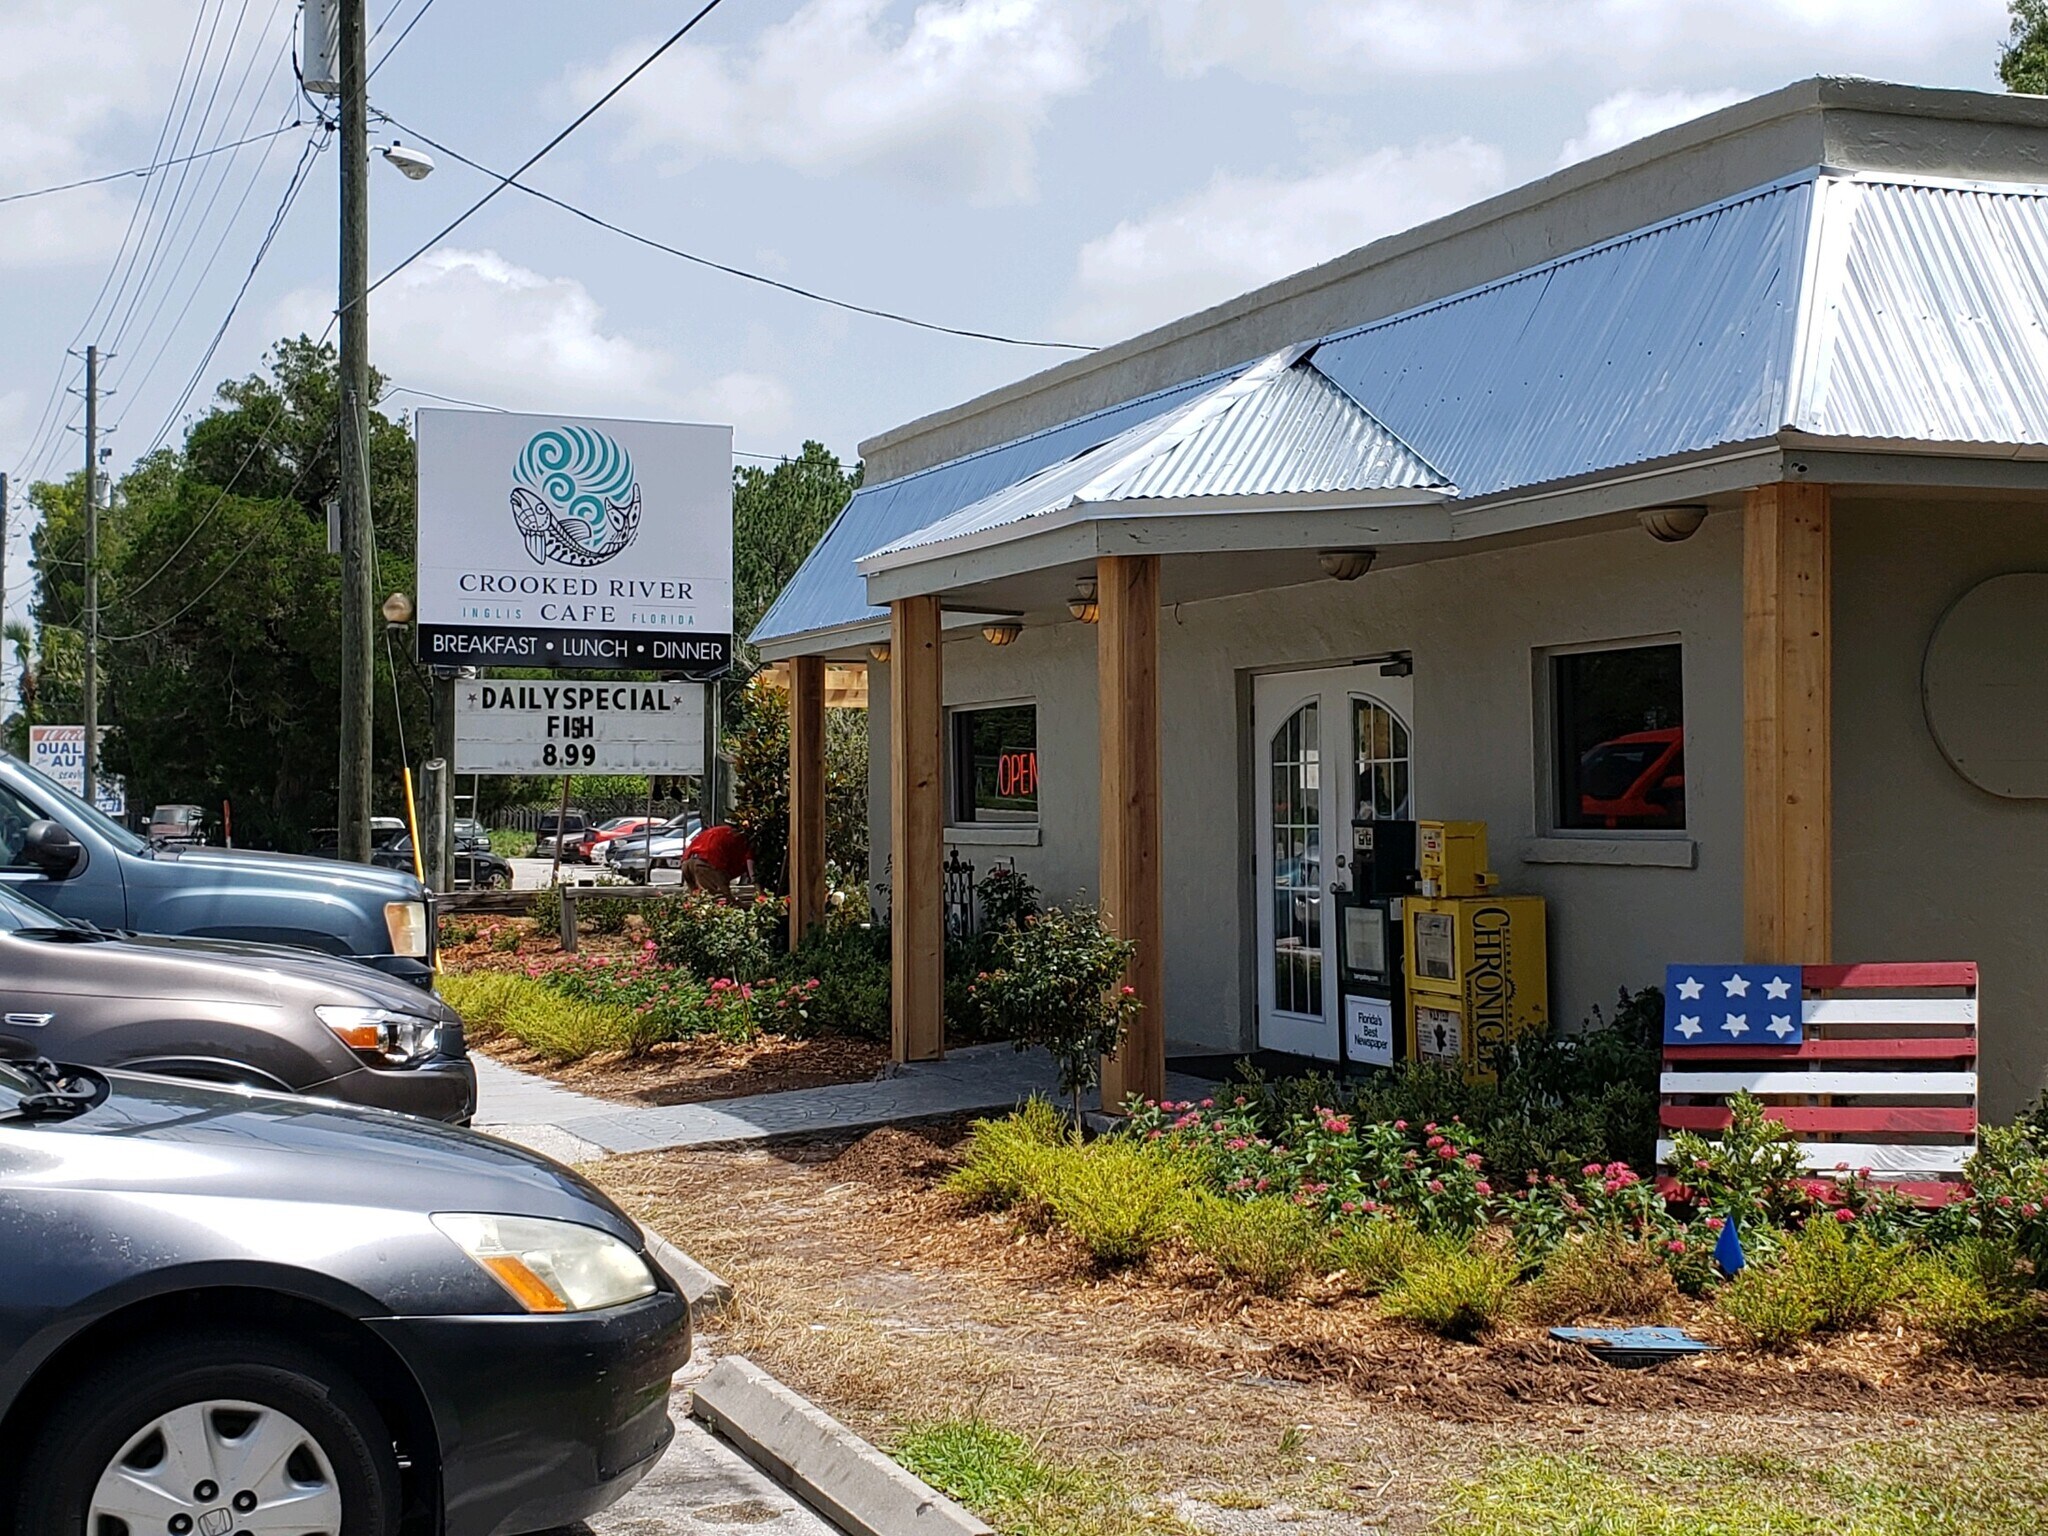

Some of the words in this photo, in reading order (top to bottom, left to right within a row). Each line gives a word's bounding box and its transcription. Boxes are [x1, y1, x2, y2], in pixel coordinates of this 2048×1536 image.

[459, 574, 598, 597] CROOKED
[610, 580, 694, 600] RIVER
[462, 606, 523, 619] INGLIS
[540, 603, 616, 623] CAFE
[632, 612, 695, 626] FLORIDA
[433, 633, 538, 655] BREAKFAST
[563, 637, 628, 658] LUNCH
[653, 640, 722, 661] DINNER
[547, 715, 594, 739] FISH
[37, 742, 82, 754] QUAL
[542, 743, 596, 767] 8.99
[51, 755, 86, 767] AUT
[1000, 752, 1038, 796] OPEN
[1465, 908, 1511, 1075] CHRONICLE
[1358, 1012, 1383, 1026] Florida's
[1354, 1034, 1388, 1050] Newspaper
[1363, 1025, 1378, 1038] Best
